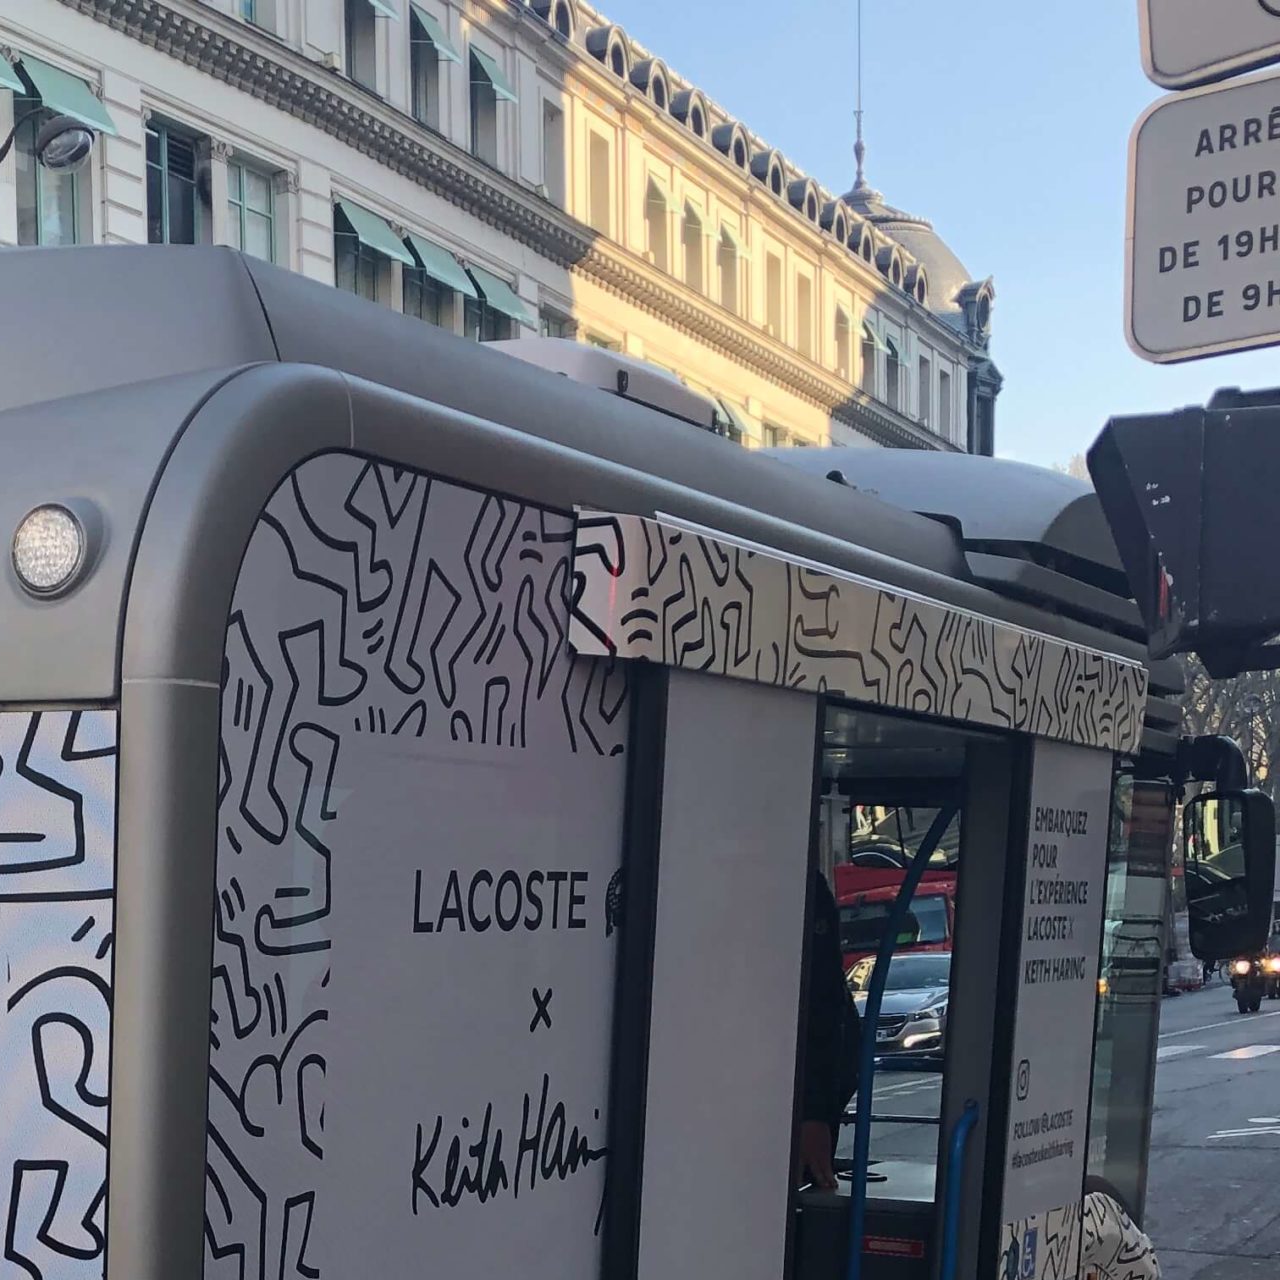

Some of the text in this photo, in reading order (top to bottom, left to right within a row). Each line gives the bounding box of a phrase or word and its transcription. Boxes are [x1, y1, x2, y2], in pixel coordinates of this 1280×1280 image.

[1186, 170, 1276, 214] POUR
[1158, 224, 1279, 273] DE 19H
[1182, 280, 1280, 322] DE 9H
[1034, 806, 1088, 837] EMBARQUEZ
[1032, 843, 1058, 869] POUR
[413, 869, 588, 933] LACOSTE
[1029, 873, 1089, 905] L'EXPÉRIENCE
[1027, 915, 1067, 941] LACOSTE
[1024, 956, 1086, 985] KEITH HARING
[412, 1102, 508, 1215] Keith
